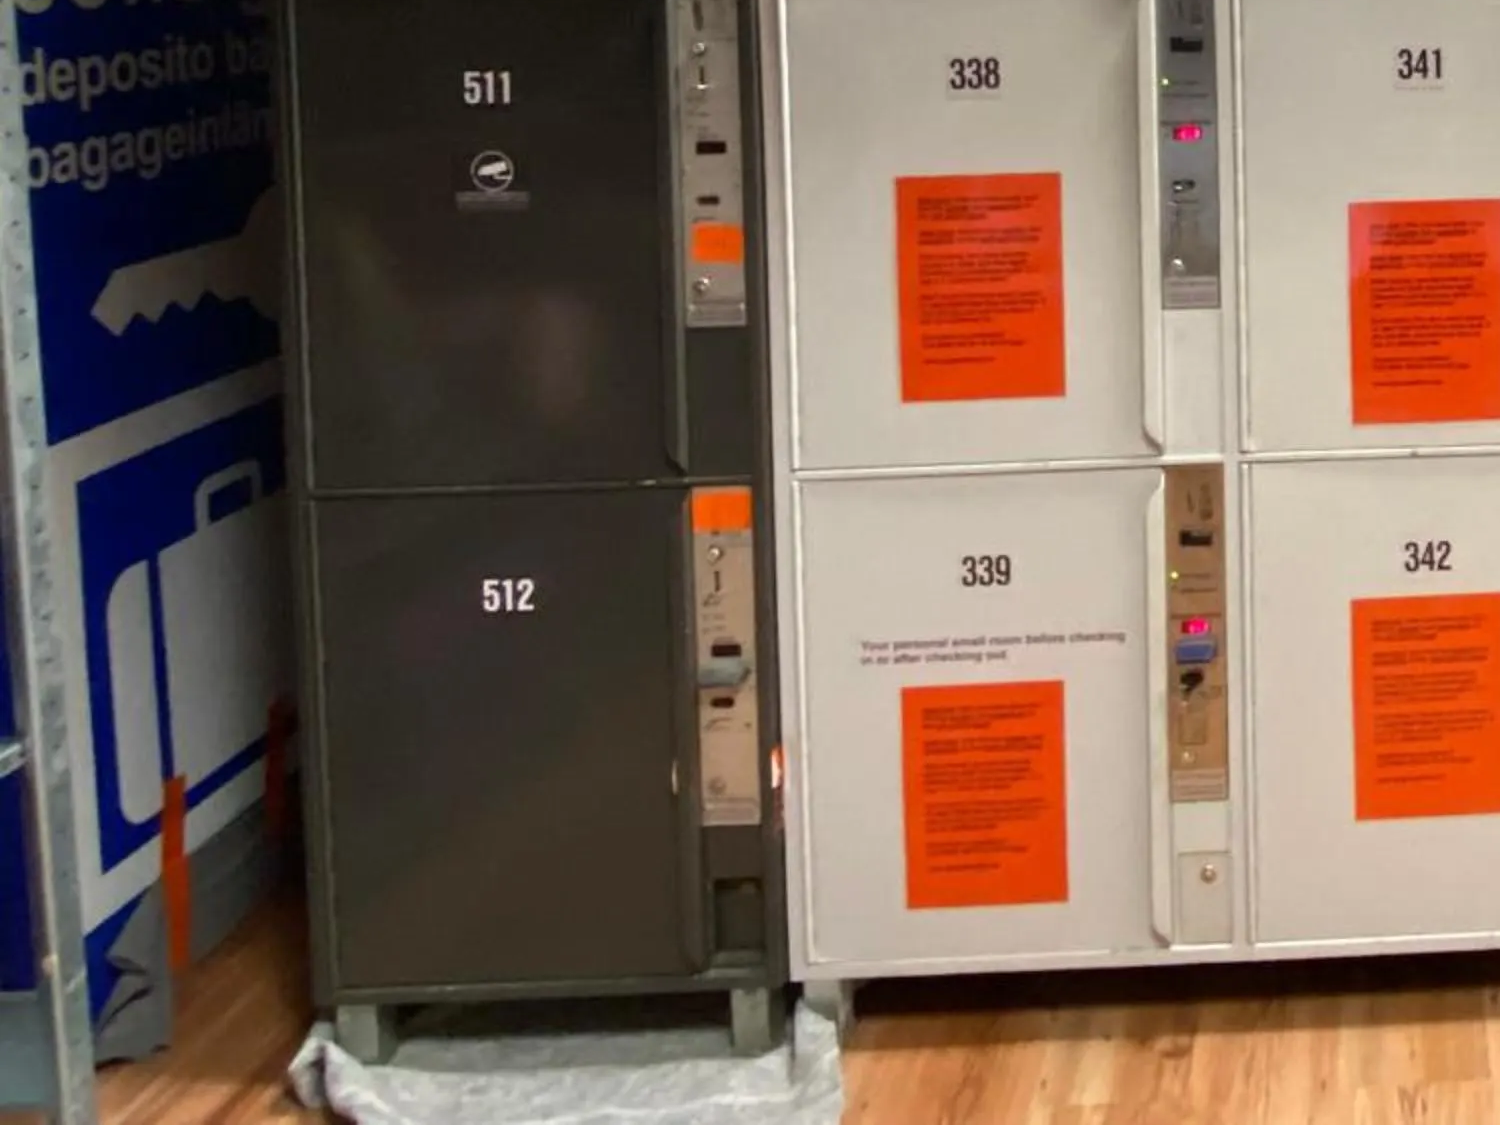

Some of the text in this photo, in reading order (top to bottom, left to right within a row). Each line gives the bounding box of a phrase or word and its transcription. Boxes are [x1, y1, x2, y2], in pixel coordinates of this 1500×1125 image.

[20, 46, 215, 112] deposito
[949, 58, 1001, 90] 338
[1397, 48, 1442, 80] 341
[463, 70, 512, 105] 511
[961, 554, 1011, 587] 339
[1403, 540, 1453, 573] 342
[482, 578, 535, 612] 512
[989, 635, 1022, 645] room
[1026, 632, 1066, 644] before
[1069, 631, 1126, 644] checking
[893, 653, 922, 665] after
[925, 650, 983, 664] checking
